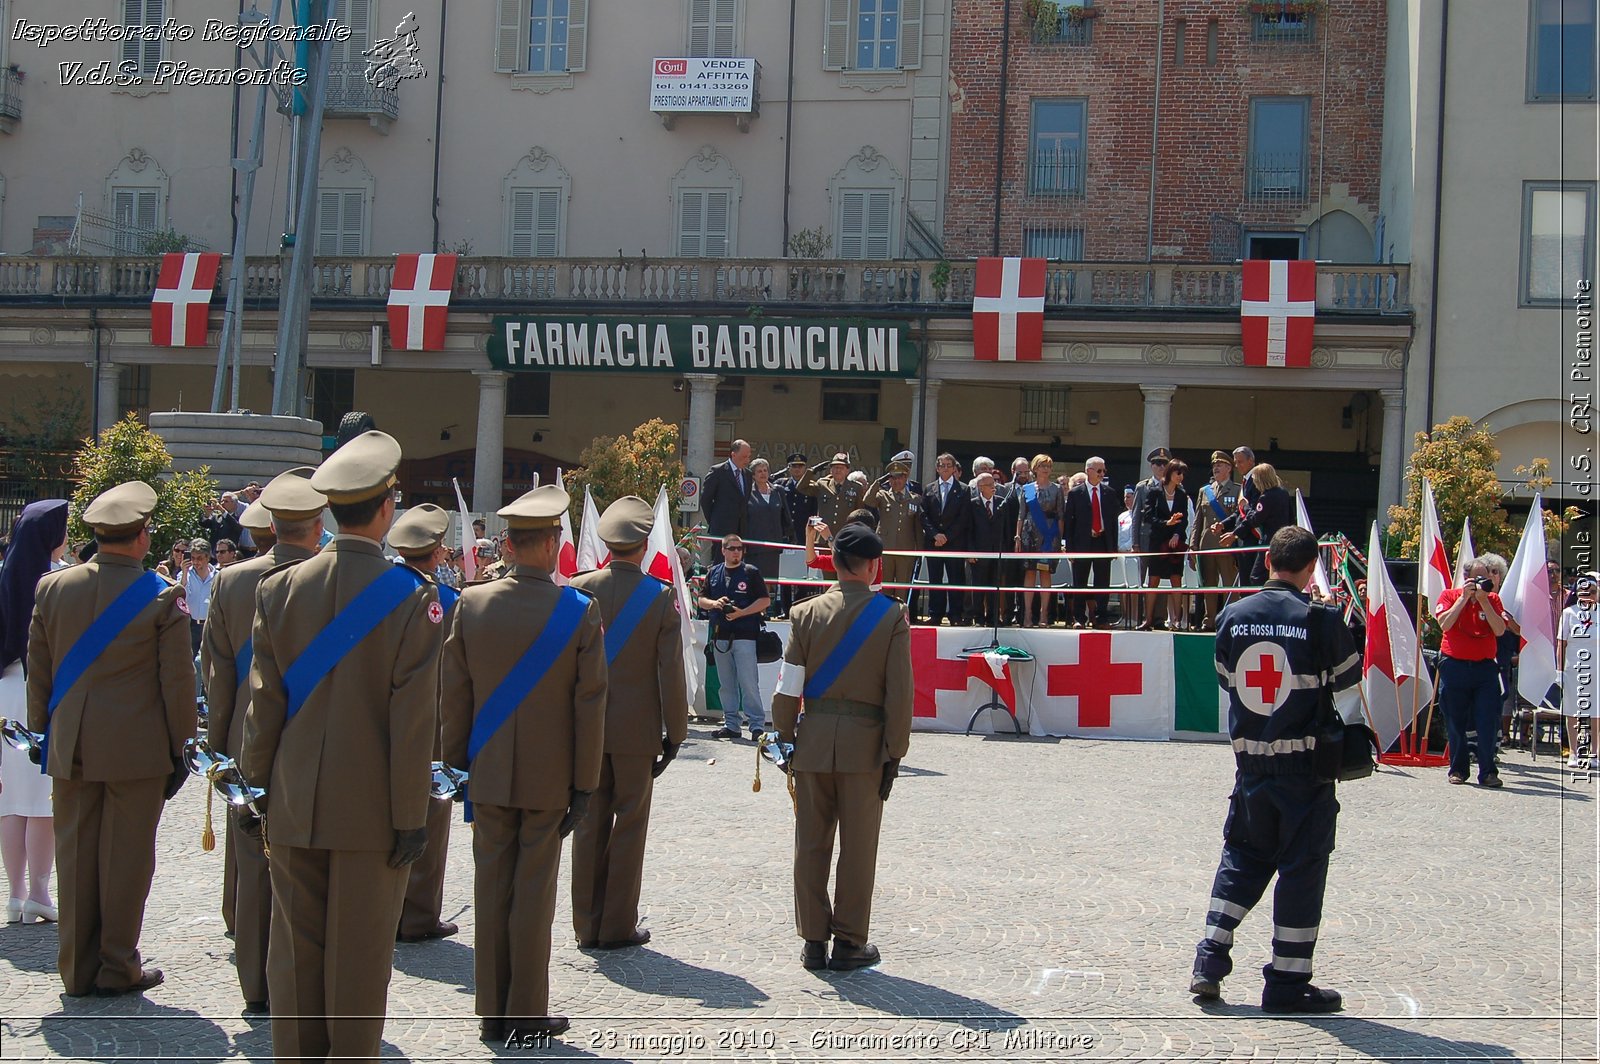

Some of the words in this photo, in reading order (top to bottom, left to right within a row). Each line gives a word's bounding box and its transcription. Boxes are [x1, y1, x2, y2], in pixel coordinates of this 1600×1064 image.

[658, 60, 683, 74] Conti
[702, 60, 745, 69] VENDE
[697, 72, 749, 80] AFFITTA
[653, 95, 687, 107] PRESTIGIOSI
[505, 322, 675, 367] FARMACIA
[692, 324, 899, 372] BARONCIANI
[1250, 624, 1274, 637] ROSSA
[1275, 624, 1307, 641] ITALIANA
